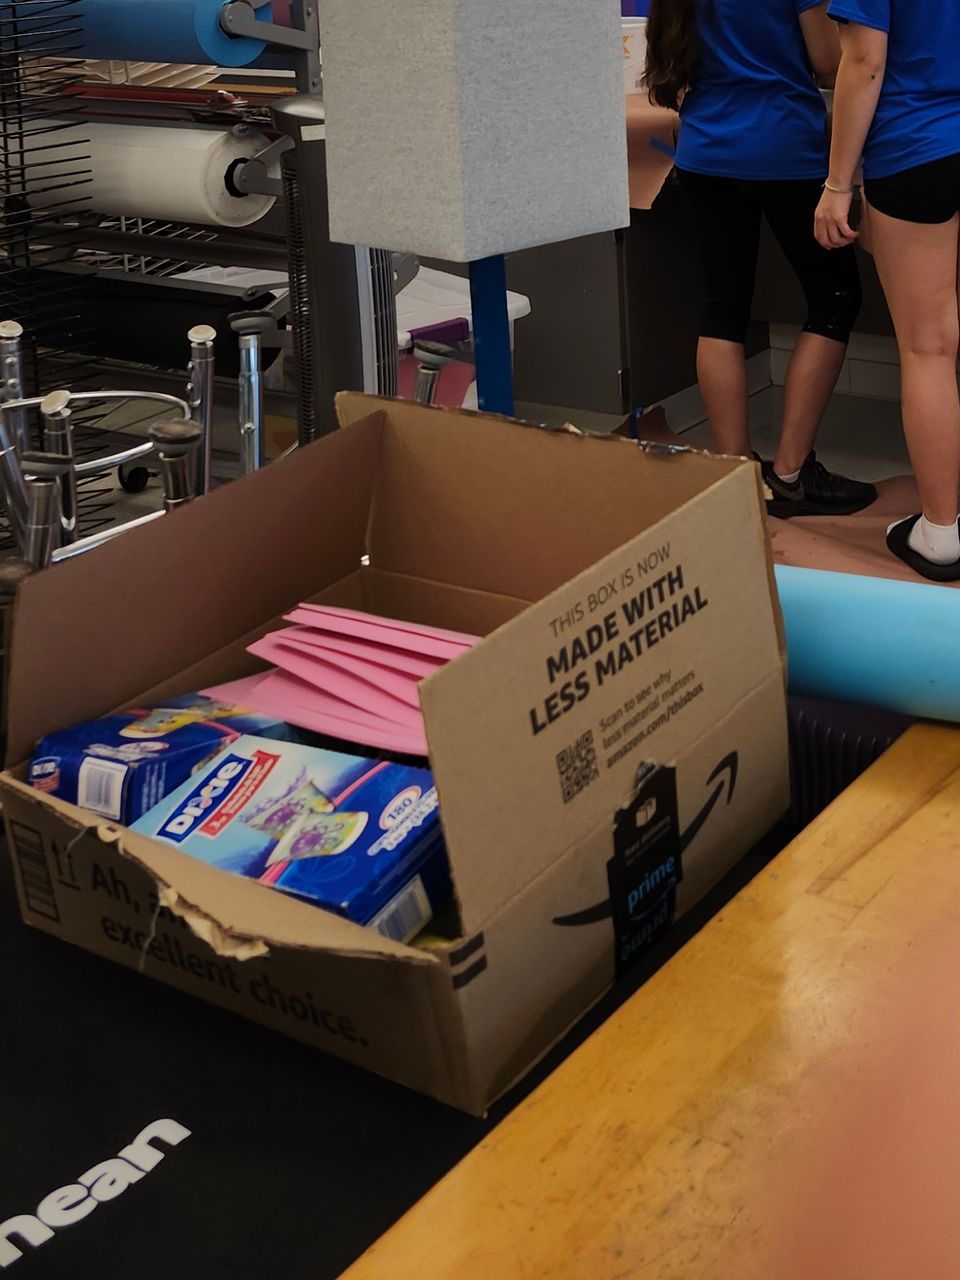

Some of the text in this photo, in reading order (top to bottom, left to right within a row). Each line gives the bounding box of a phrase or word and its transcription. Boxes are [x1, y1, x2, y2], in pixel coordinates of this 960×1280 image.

[546, 565, 685, 683] MADE WITH
[549, 542, 671, 638] THIS BOX IS NOW
[529, 587, 708, 736] LESS MATERIAL
[599, 670, 672, 731] Scan to see why
[602, 670, 697, 750] less material matters
[606, 681, 704, 769] amazon.com/thisbox
[388, 798, 413, 820] 180
[91, 862, 141, 914] Ah,
[627, 855, 675, 914] prime
[102, 914, 369, 1048] excellent choice.
